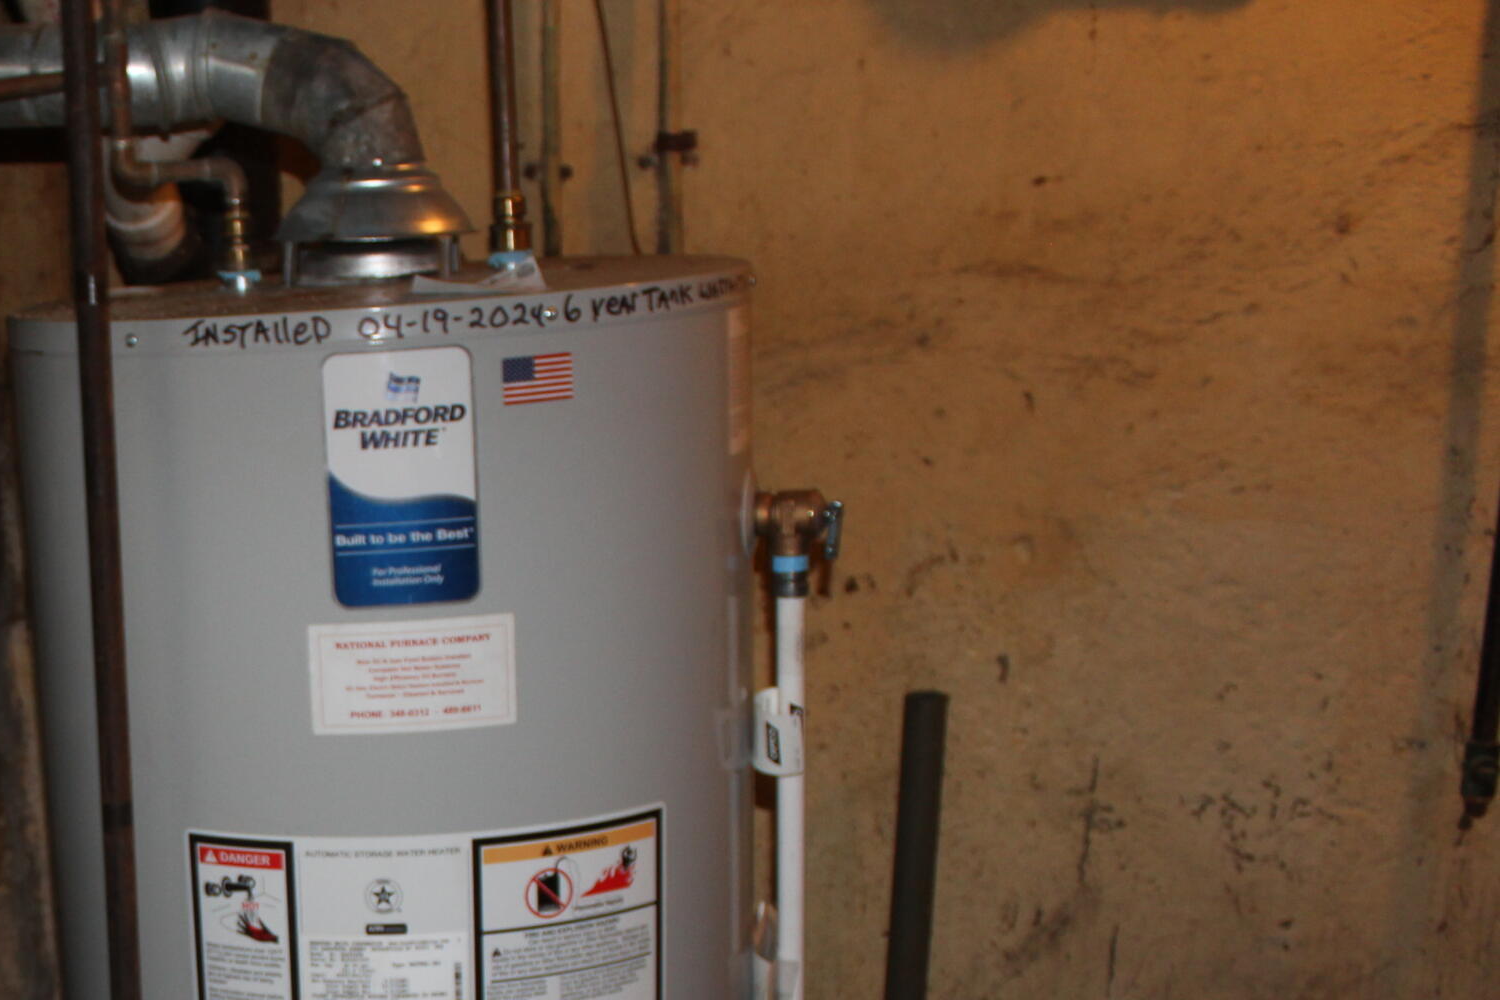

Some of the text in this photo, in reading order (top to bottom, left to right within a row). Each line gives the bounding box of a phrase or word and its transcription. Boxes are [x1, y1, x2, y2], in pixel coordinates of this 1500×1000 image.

[563, 294, 582, 323] 6
[333, 403, 467, 430] BRADFORD
[360, 428, 439, 450] WHITE
[335, 534, 366, 547] Built
[370, 534, 384, 544] to
[387, 532, 406, 543] be
[410, 530, 433, 542] the
[442, 633, 492, 644] COMPANY
[556, 836, 609, 853] WARNING
[219, 852, 271, 866] DANGER
